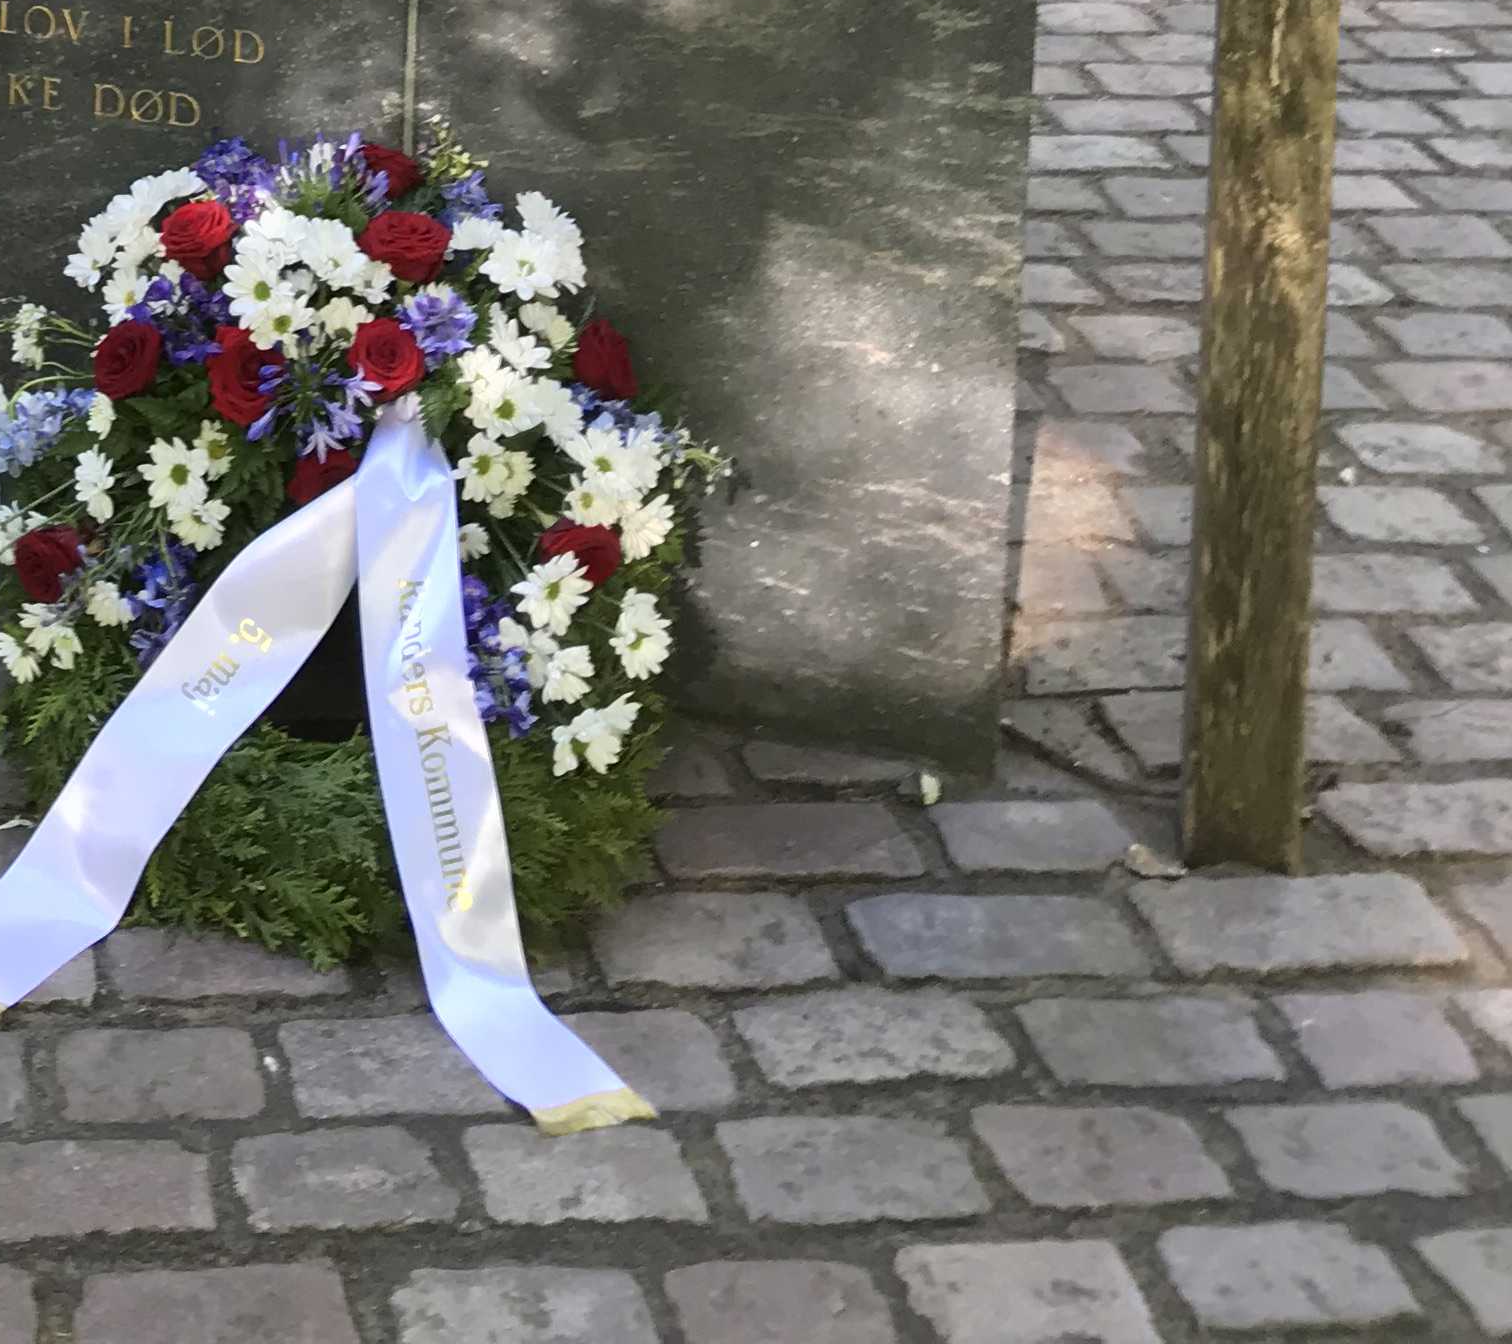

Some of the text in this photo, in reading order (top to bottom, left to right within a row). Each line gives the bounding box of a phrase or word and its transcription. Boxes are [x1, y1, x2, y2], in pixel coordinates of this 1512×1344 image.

[0, 0, 88, 45] LOV
[122, 15, 134, 49] I
[163, 17, 265, 64] LØD
[93, 83, 202, 128] DØD
[182, 618, 272, 716] 5. maj
[398, 577, 473, 912] Randers Kommune
